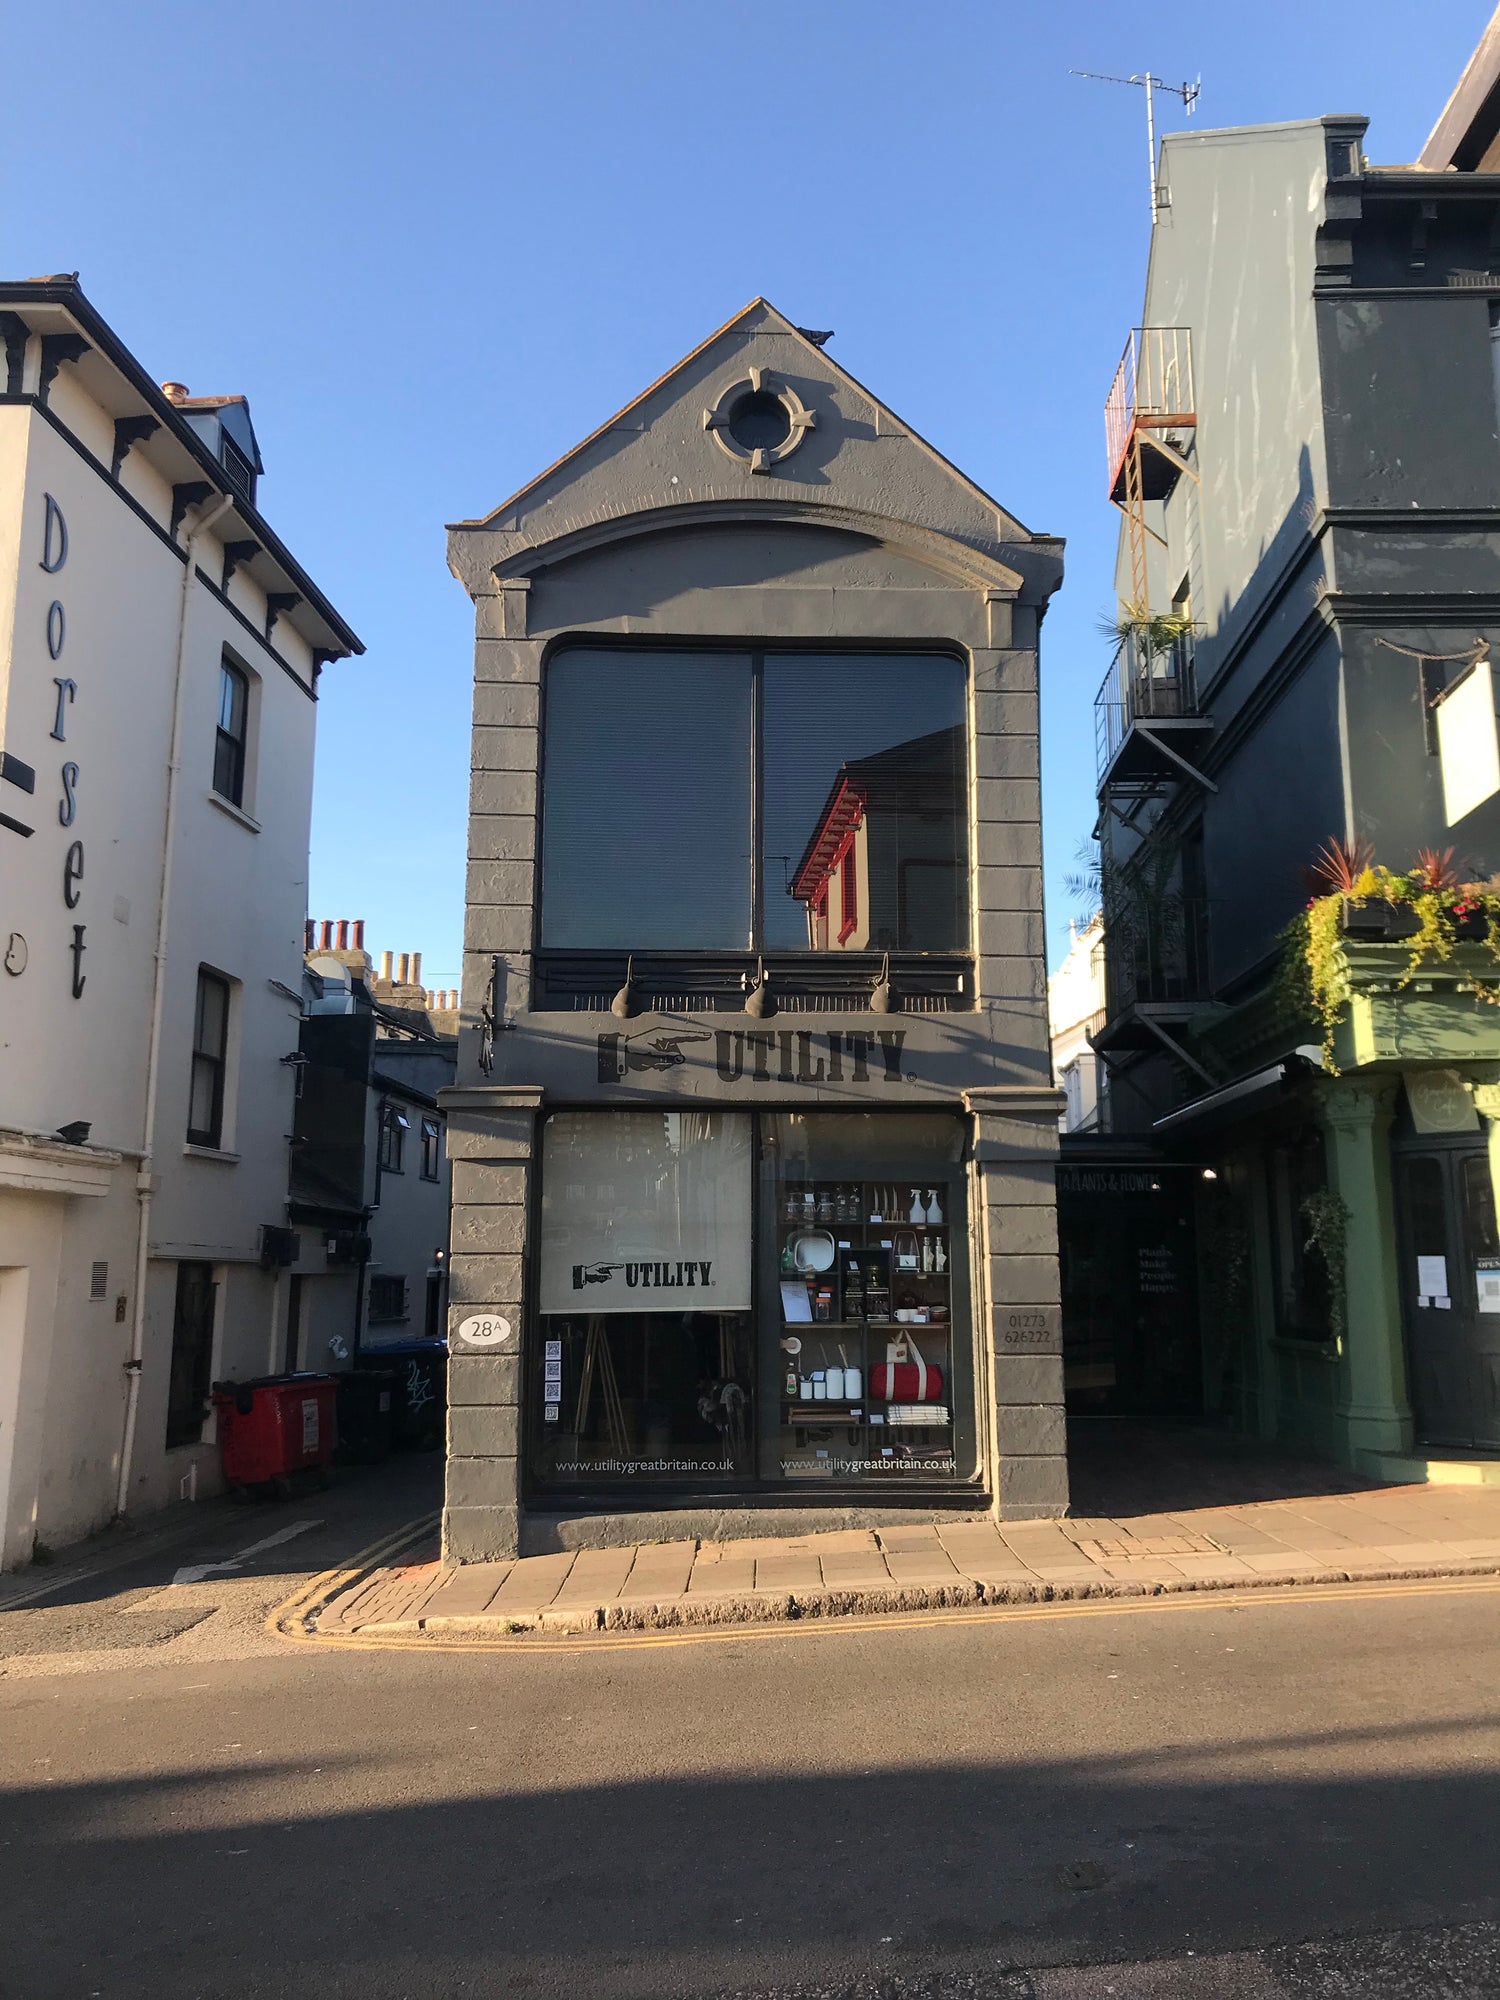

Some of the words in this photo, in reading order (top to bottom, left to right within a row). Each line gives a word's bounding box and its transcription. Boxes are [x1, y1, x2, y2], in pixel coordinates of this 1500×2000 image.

[39, 492, 87, 1000] Dorset
[715, 1030, 907, 1083] UTILITY
[625, 1261, 712, 1288] UTILITY
[471, 1321, 502, 1337] 28A
[1009, 1315, 1046, 1328] 01273
[1004, 1330, 1051, 1343] 626222
[555, 1458, 735, 1474] www.utilitygreatbritain.co.uk
[779, 1457, 957, 1474] www.utilitygreatbritain.co.uk
